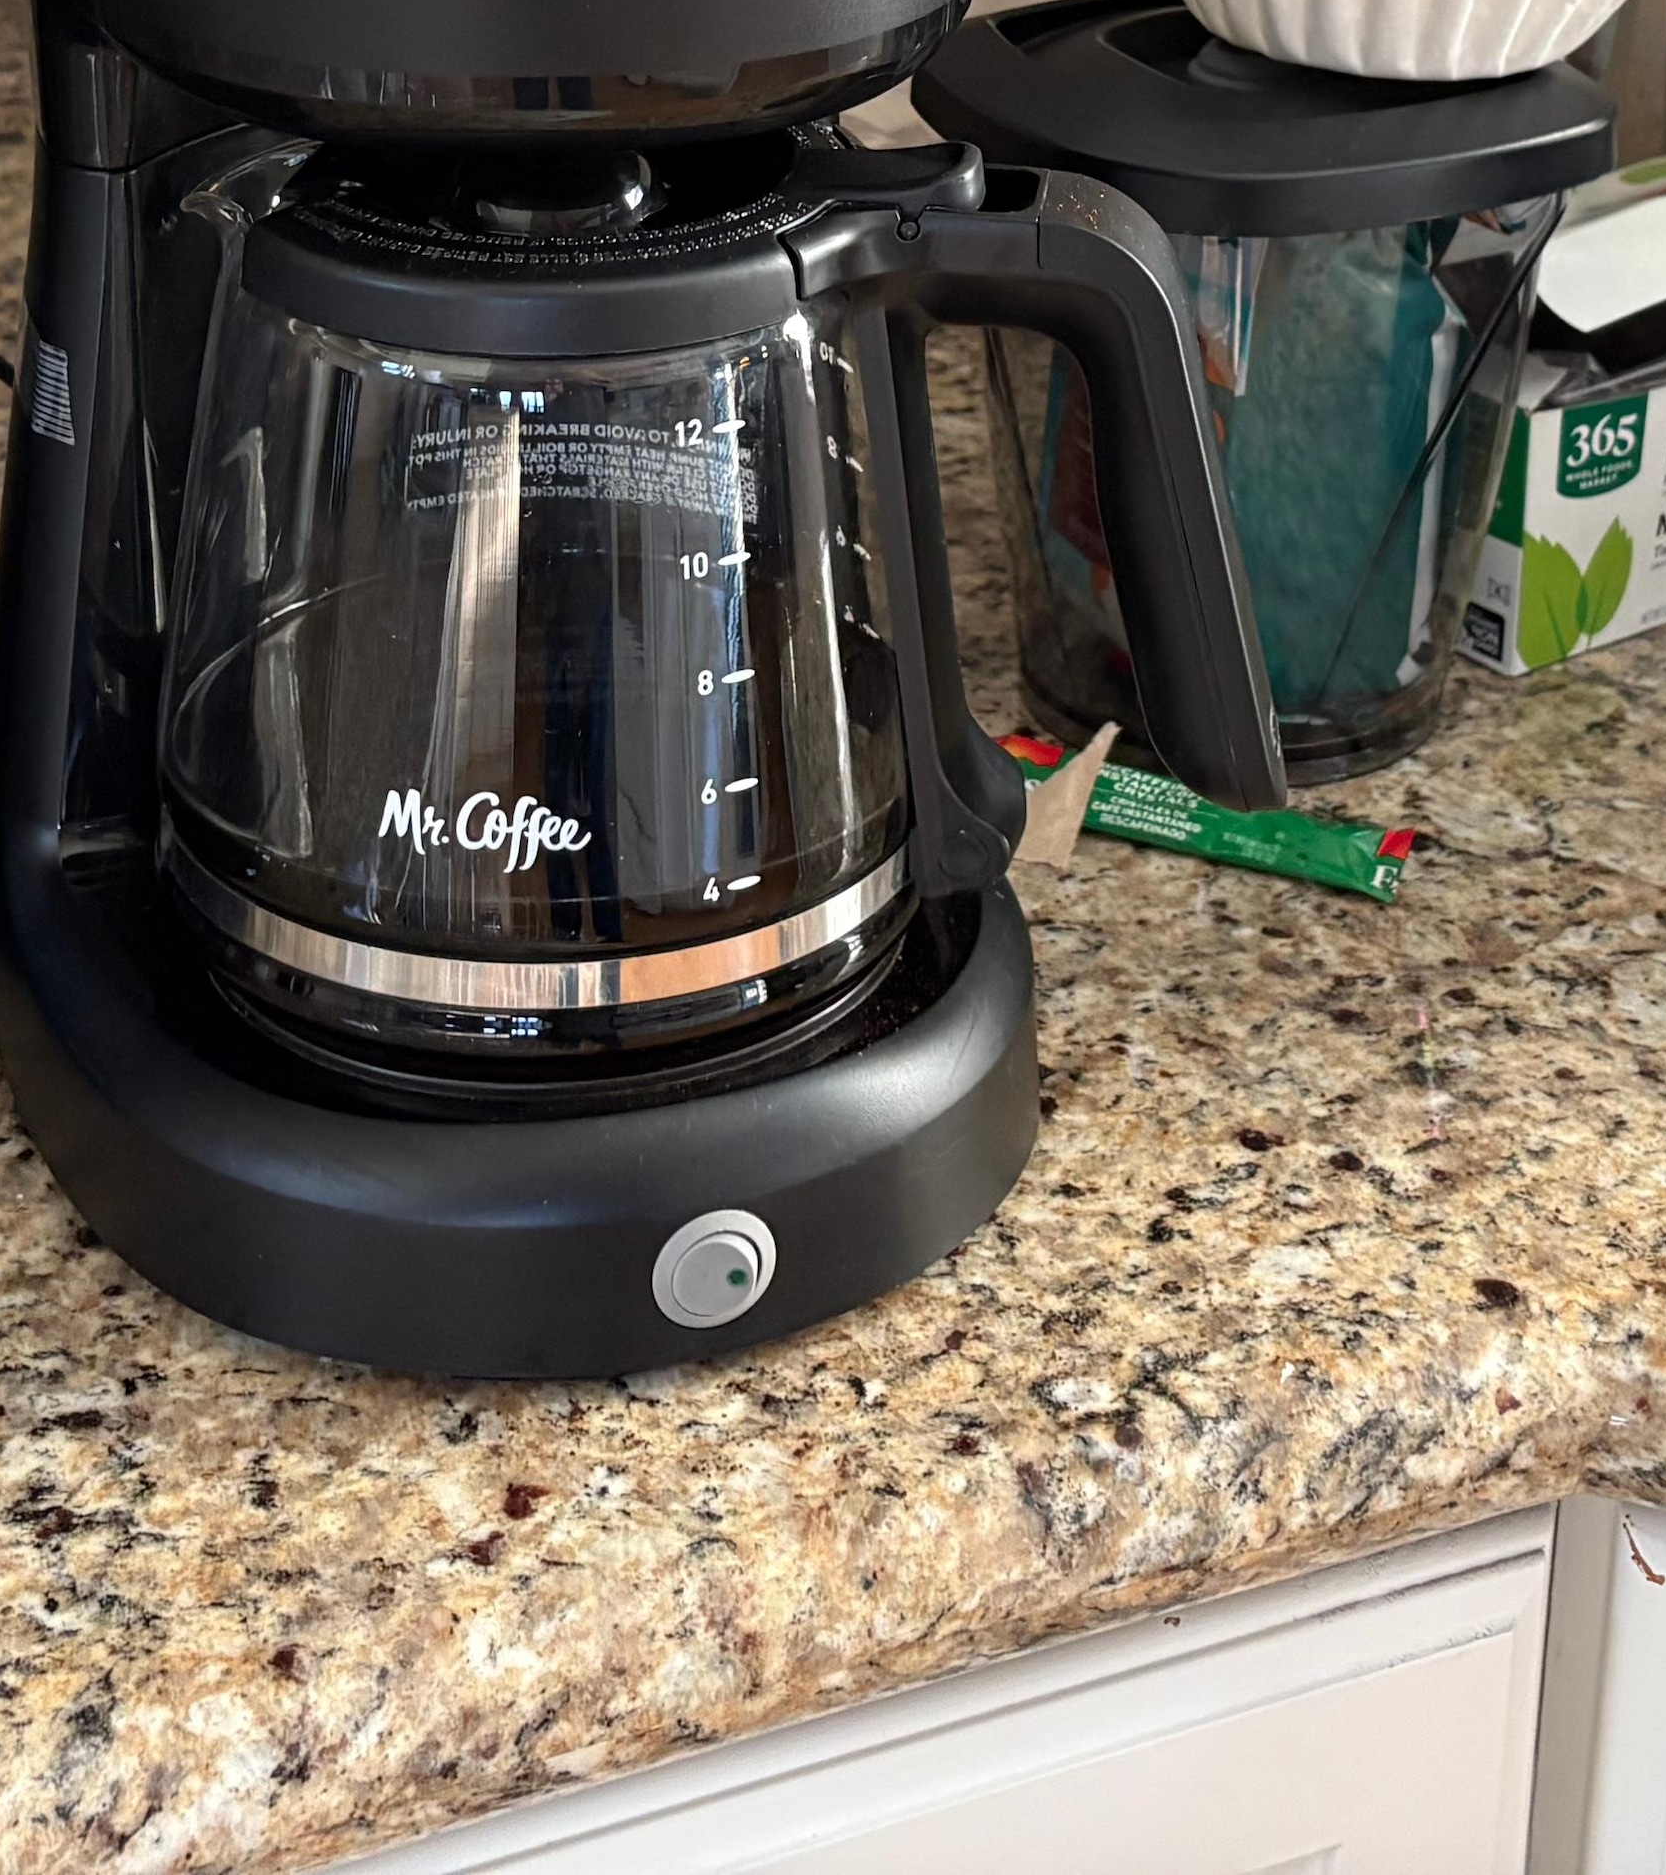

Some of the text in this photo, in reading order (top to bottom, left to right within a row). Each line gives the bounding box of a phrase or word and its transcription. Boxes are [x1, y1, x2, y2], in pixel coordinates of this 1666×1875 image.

[674, 420, 703, 447] 12
[1566, 413, 1639, 468] 365
[679, 553, 709, 581] 10
[697, 671, 714, 695] 8
[701, 781, 717, 805] 6
[379, 789, 592, 875] Mr. Coffee
[702, 876, 720, 903] 4
